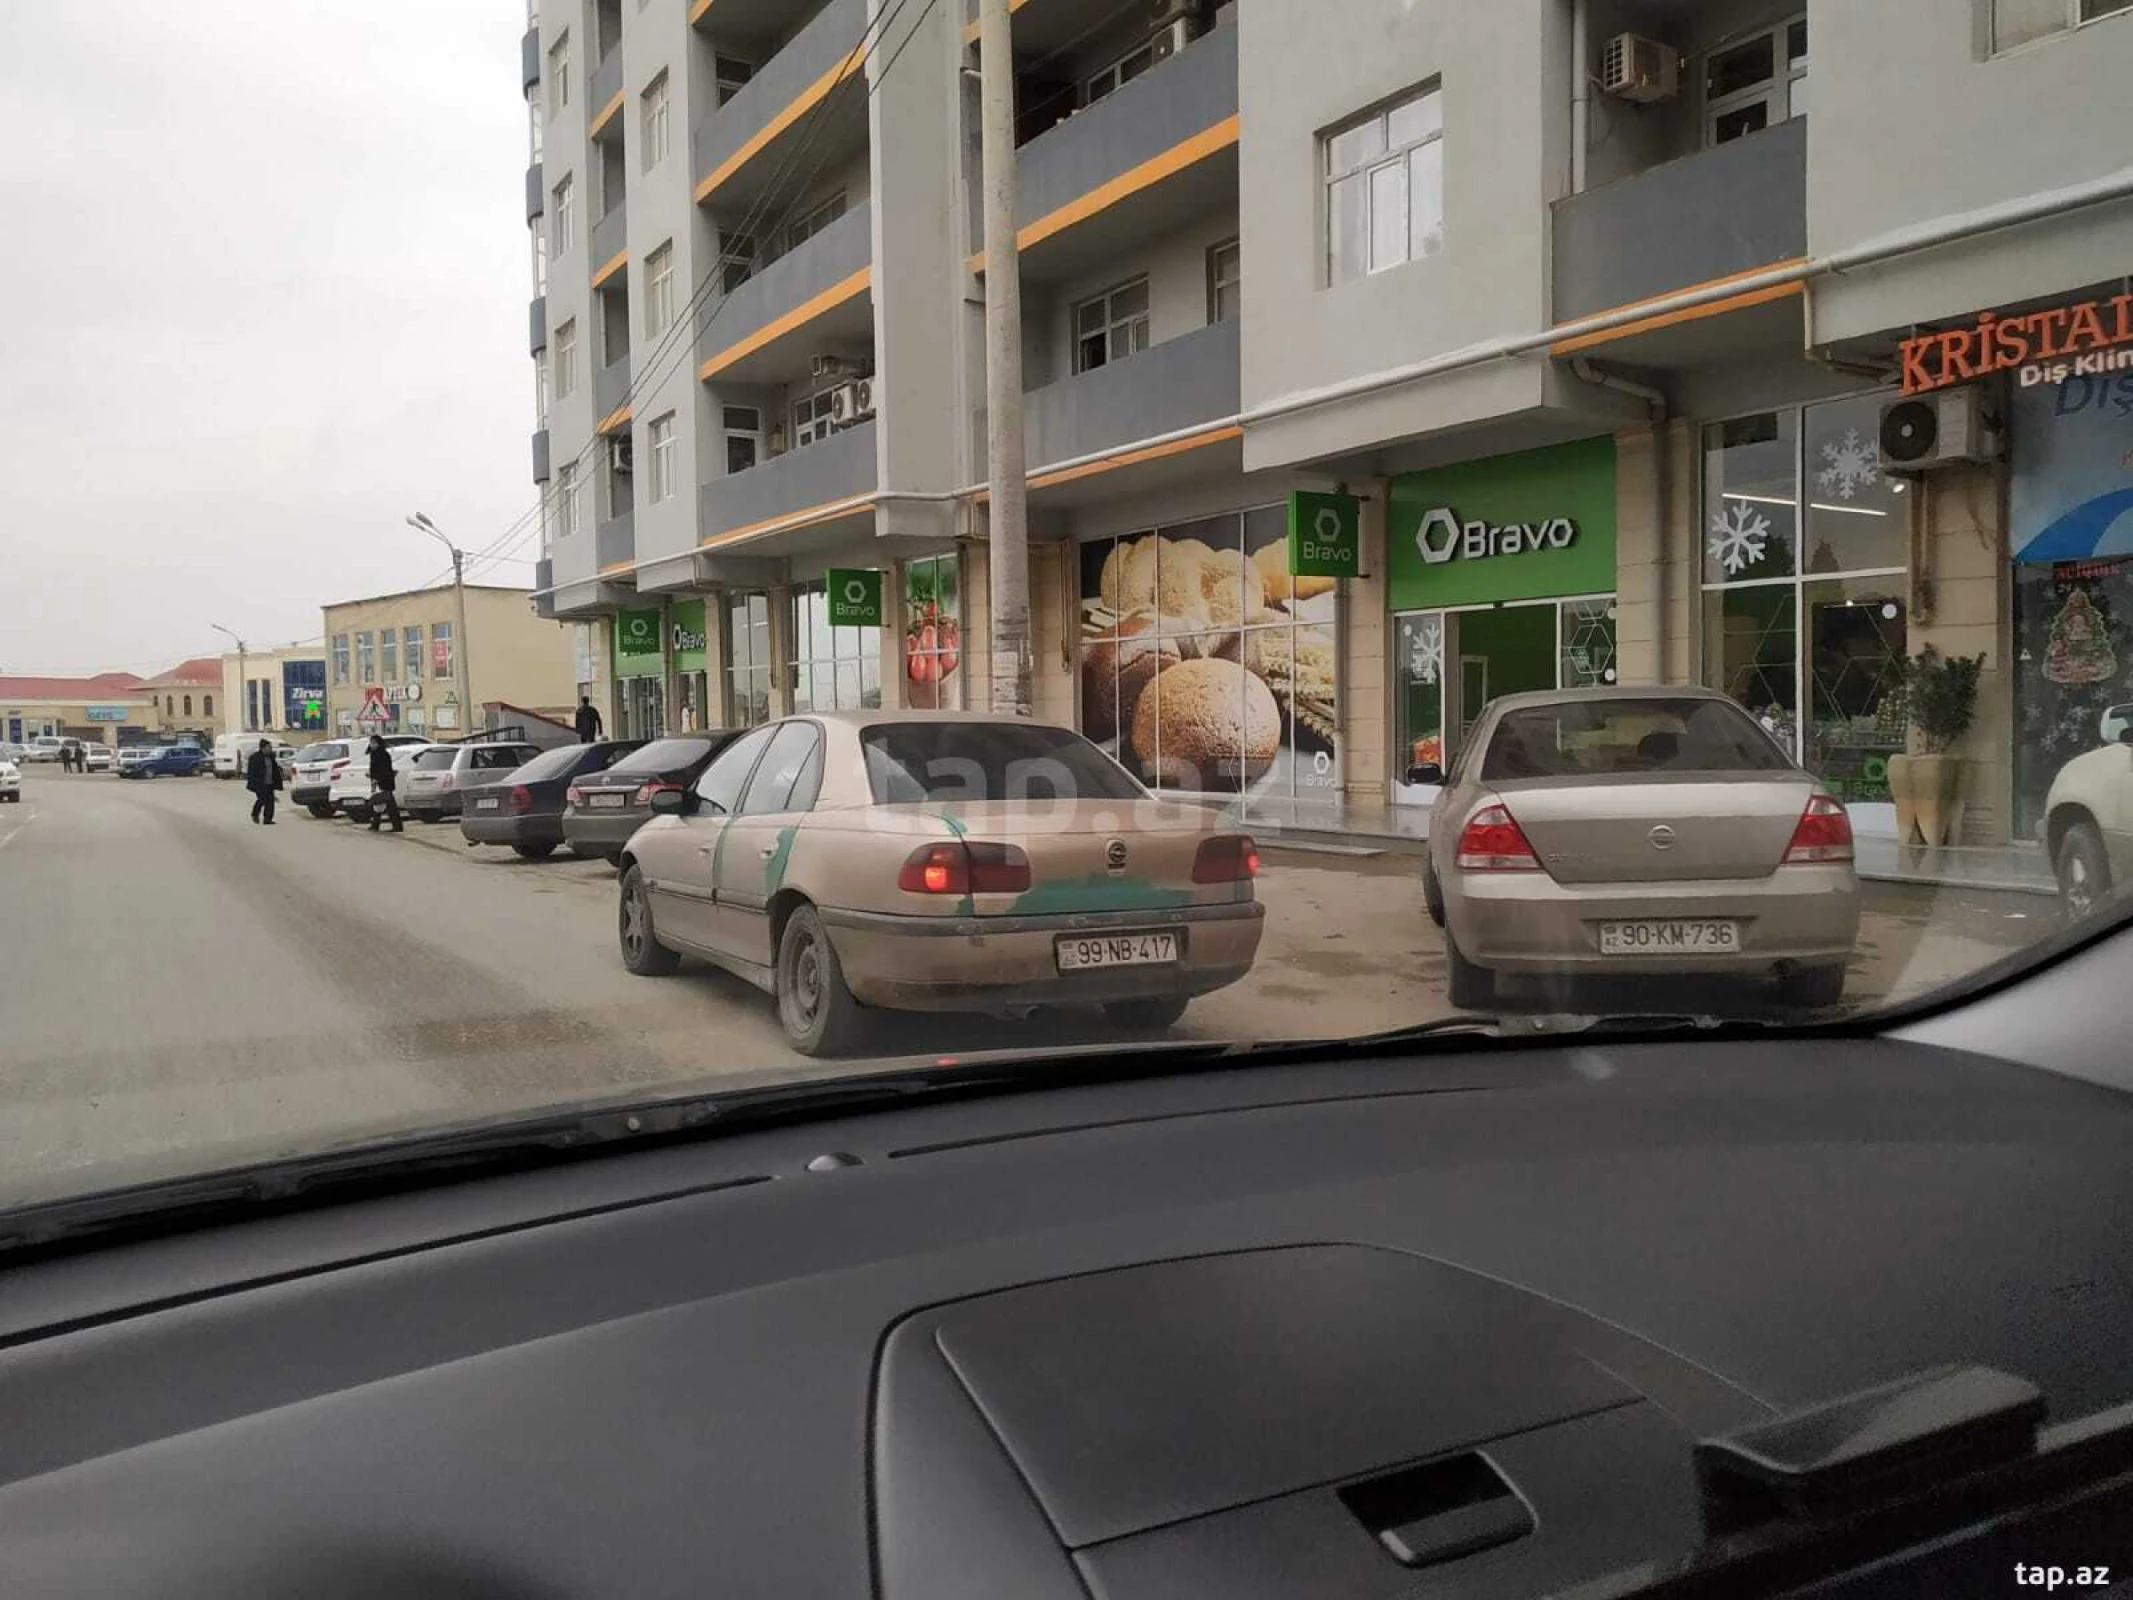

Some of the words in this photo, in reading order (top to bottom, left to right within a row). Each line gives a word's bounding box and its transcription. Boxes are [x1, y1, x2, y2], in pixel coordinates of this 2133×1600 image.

[1462, 518, 1574, 559] Bravo
[1303, 541, 1351, 561] Bravo
[836, 602, 875, 617] Bravo
[623, 633, 655, 646] Bravo
[1622, 923, 1733, 946] 90-KM-736
[1078, 936, 1172, 965] 99-NB-417
